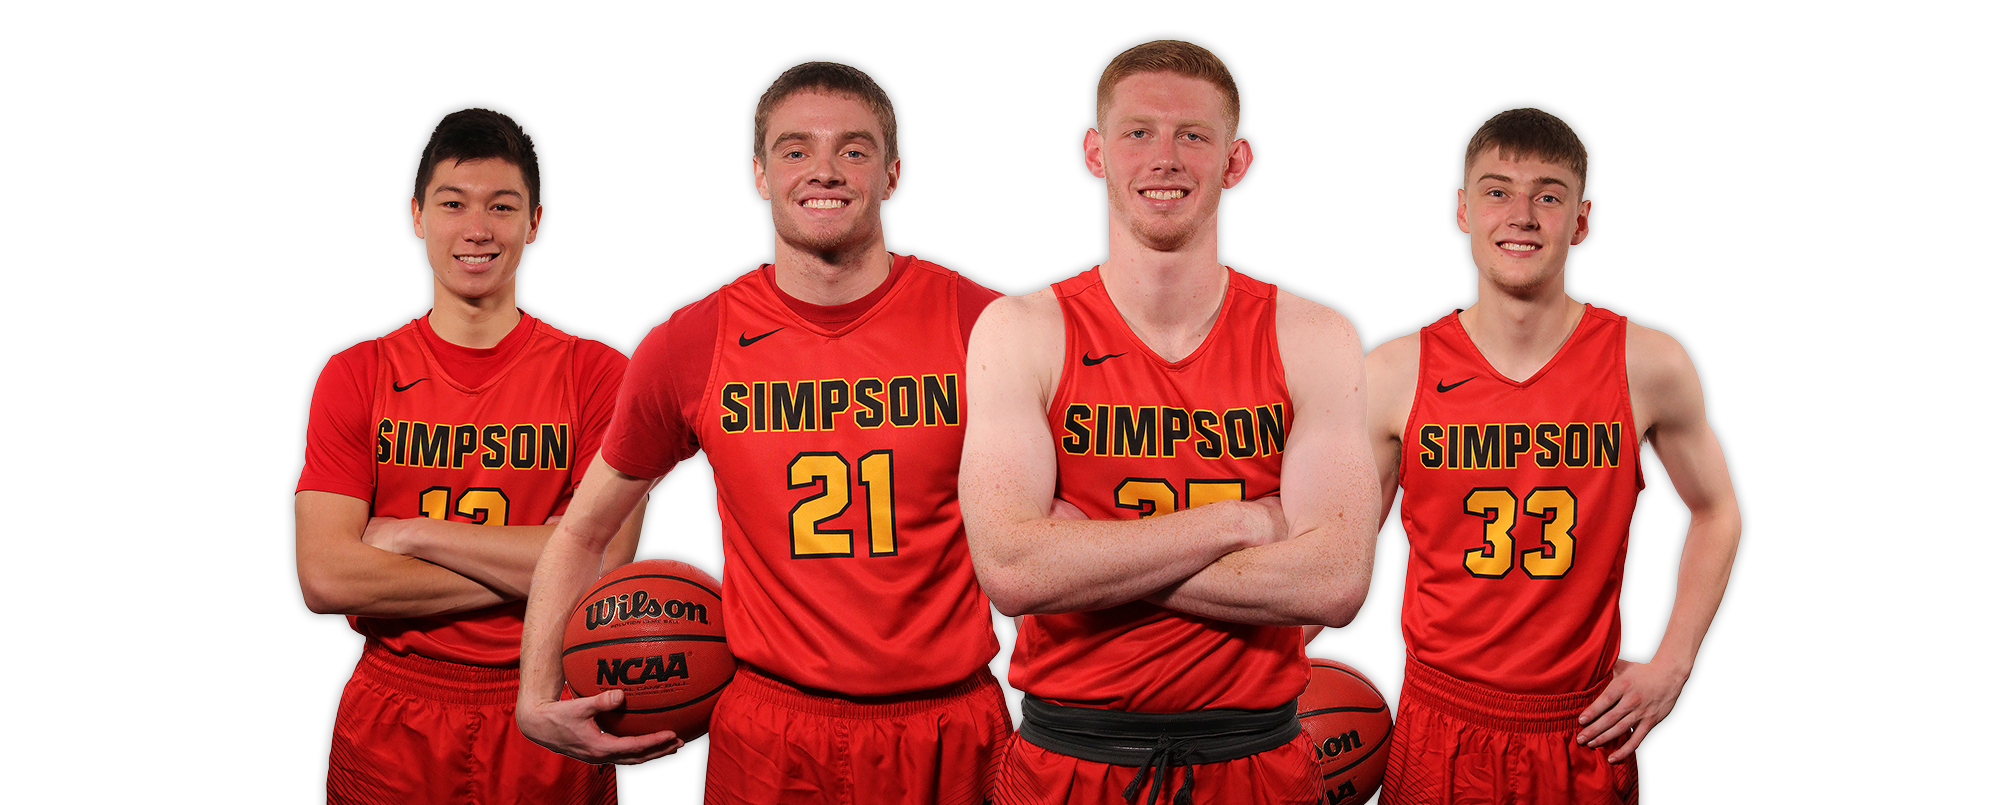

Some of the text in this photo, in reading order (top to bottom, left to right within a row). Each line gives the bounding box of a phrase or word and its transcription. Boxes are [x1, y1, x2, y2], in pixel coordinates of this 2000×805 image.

[721, 373, 960, 434] SIMPSON
[1061, 402, 1285, 460] SIMPSON
[377, 417, 569, 471] SIMPSON
[1419, 421, 1622, 470] SIMPSON
[786, 449, 898, 559] 21
[1462, 486, 1578, 579] 33
[585, 590, 709, 631] Wilson
[596, 652, 689, 686] NCAA
